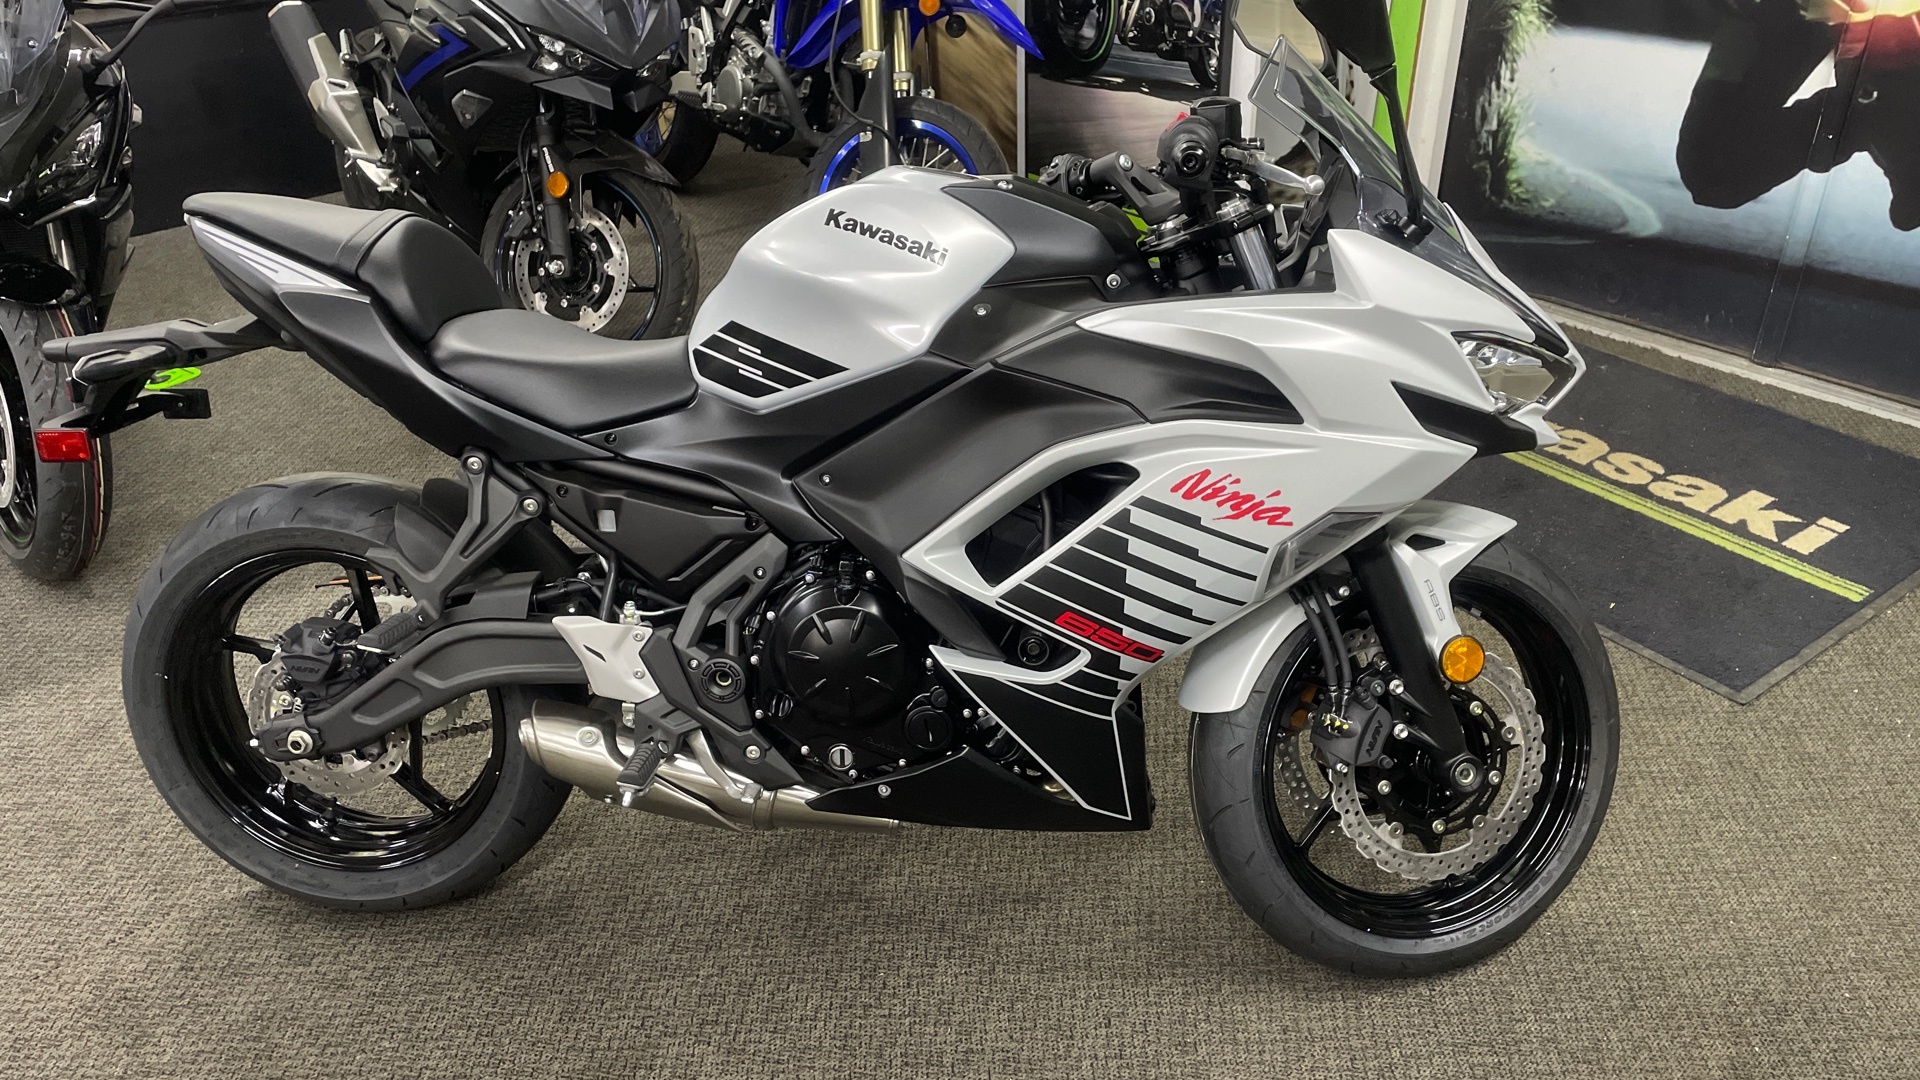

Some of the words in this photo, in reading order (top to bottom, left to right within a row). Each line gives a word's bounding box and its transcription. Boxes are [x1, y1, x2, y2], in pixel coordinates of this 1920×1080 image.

[824, 208, 949, 267] Kawasaki
[1170, 468, 1293, 527] Ninja
[1544, 420, 1850, 555] asaki
[1424, 578, 1446, 622] ABS
[1055, 611, 1165, 662] 650
